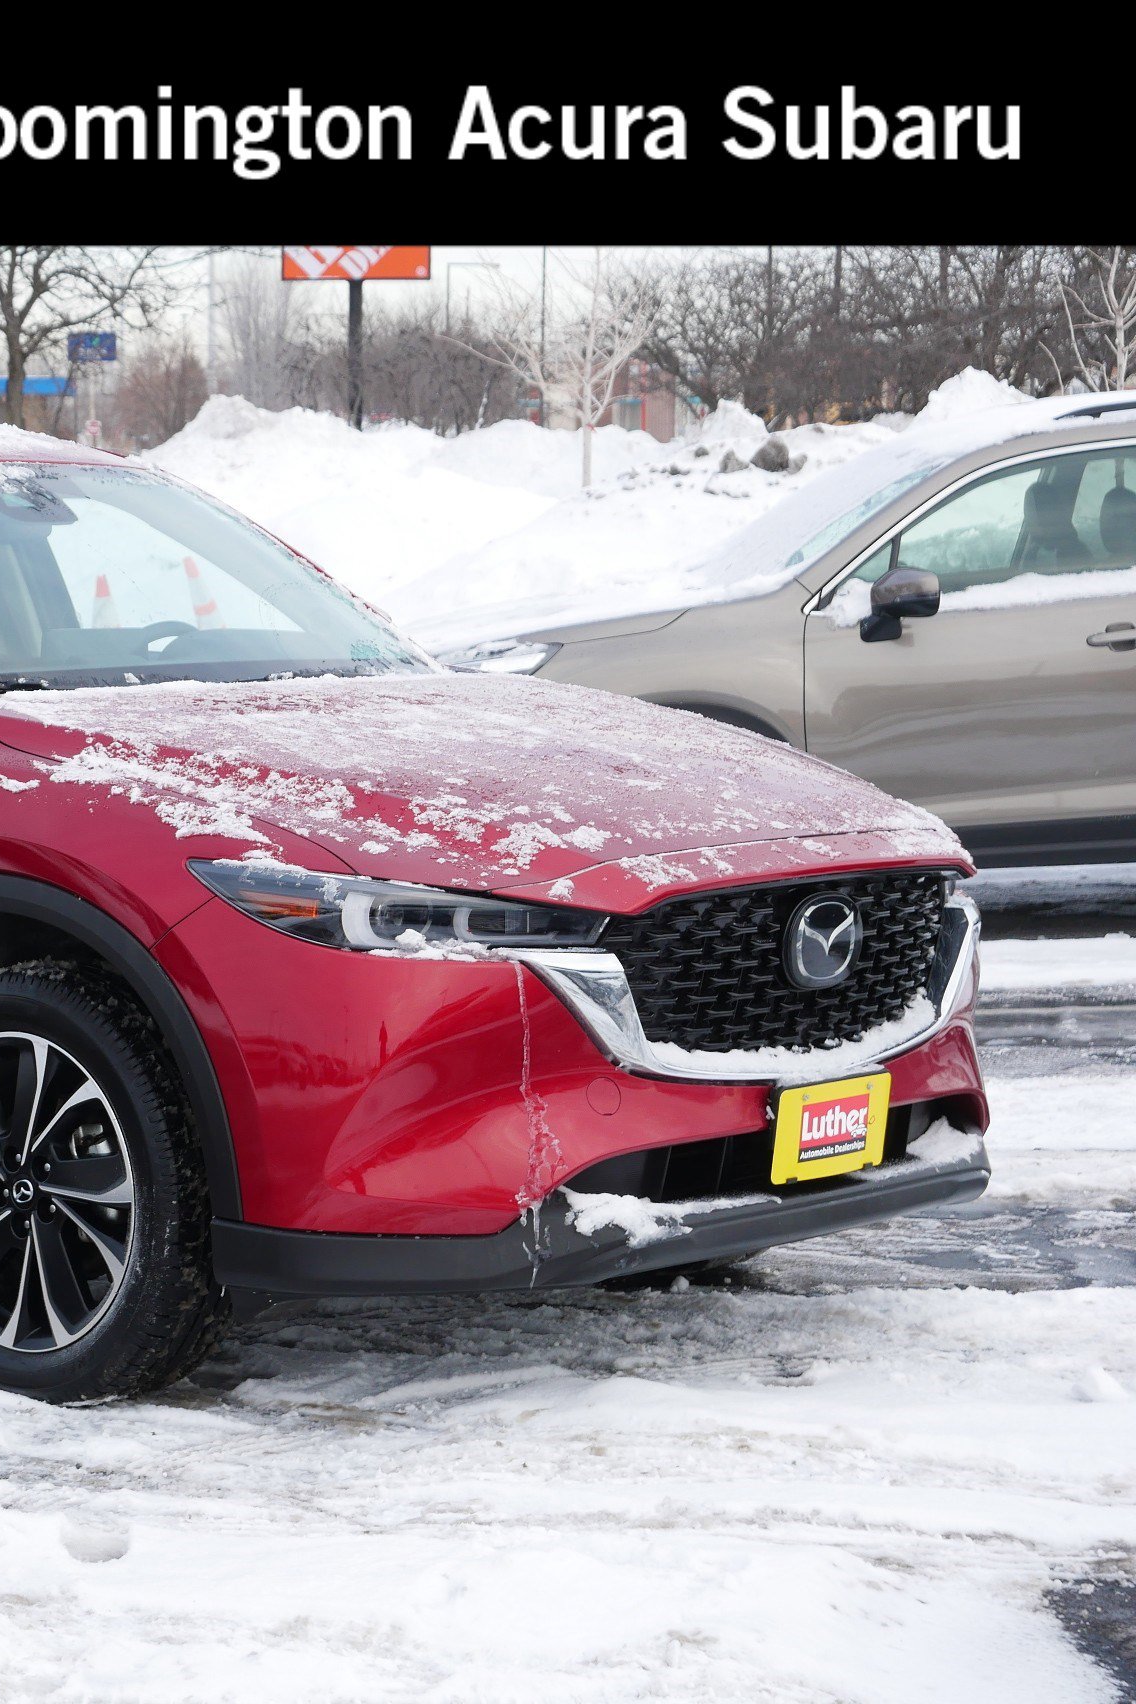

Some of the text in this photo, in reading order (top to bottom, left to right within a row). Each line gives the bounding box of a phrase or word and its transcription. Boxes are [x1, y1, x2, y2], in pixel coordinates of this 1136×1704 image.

[801, 1105, 868, 1142] Luther
[800, 1140, 865, 1160] Automobile Dealerships
